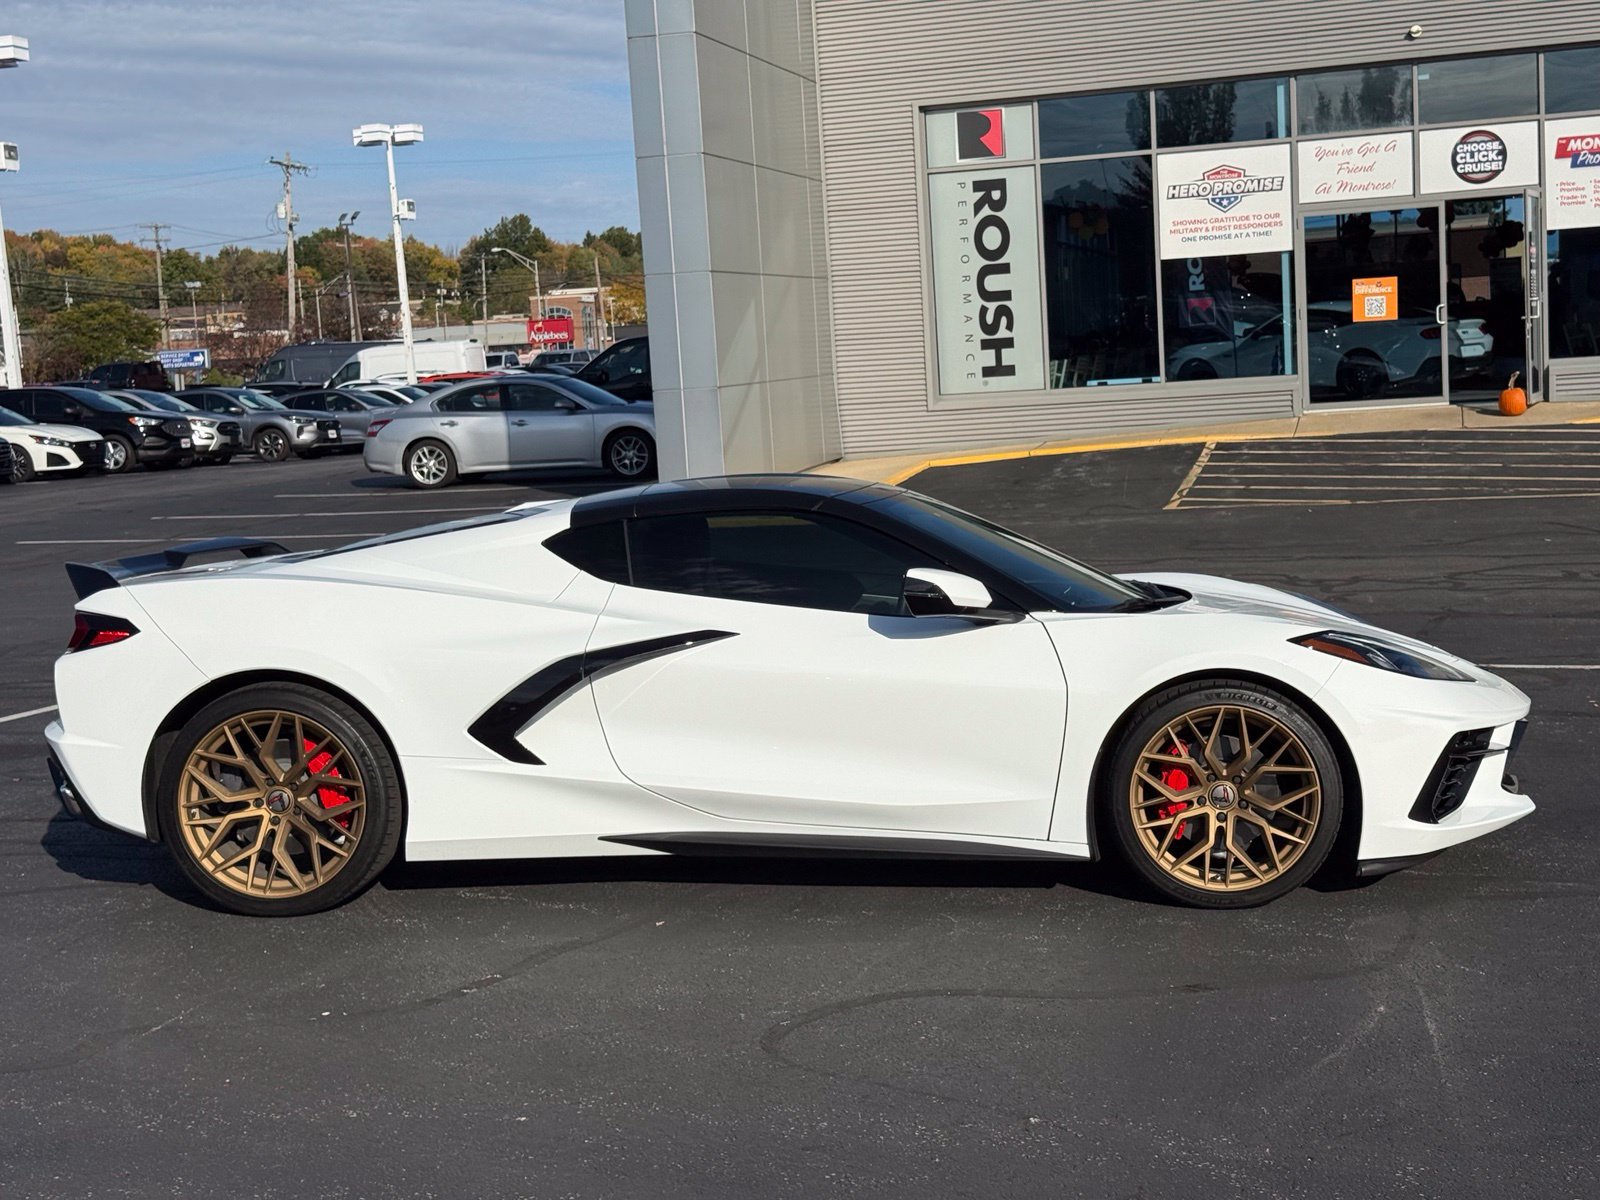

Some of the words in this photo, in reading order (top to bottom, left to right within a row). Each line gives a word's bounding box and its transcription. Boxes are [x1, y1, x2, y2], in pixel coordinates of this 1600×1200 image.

[1315, 143, 1353, 162] You've
[1357, 141, 1381, 158] Got
[1384, 139, 1397, 153] A
[1456, 141, 1503, 153] CHOOSE.
[1456, 150, 1503, 163] CLICK.
[1336, 160, 1377, 175] Friend
[1456, 161, 1503, 173] CRUISE!
[1167, 181, 1212, 200] HERO
[1212, 176, 1284, 196] PROMISE
[1315, 182, 1332, 195] At
[1336, 179, 1396, 193] Montrose!
[1170, 227, 1203, 235] MILITARY
[1233, 221, 1283, 230] RESPONDERS
[1172, 217, 1208, 227] SHOWING
[1209, 215, 1250, 224] GRATITUDE
[957, 182, 976, 379] PERFORMANCE
[972, 178, 1016, 378] ROUSH
[530, 330, 569, 342] Applebee's
[1219, 692, 1275, 710] MICHELIN
